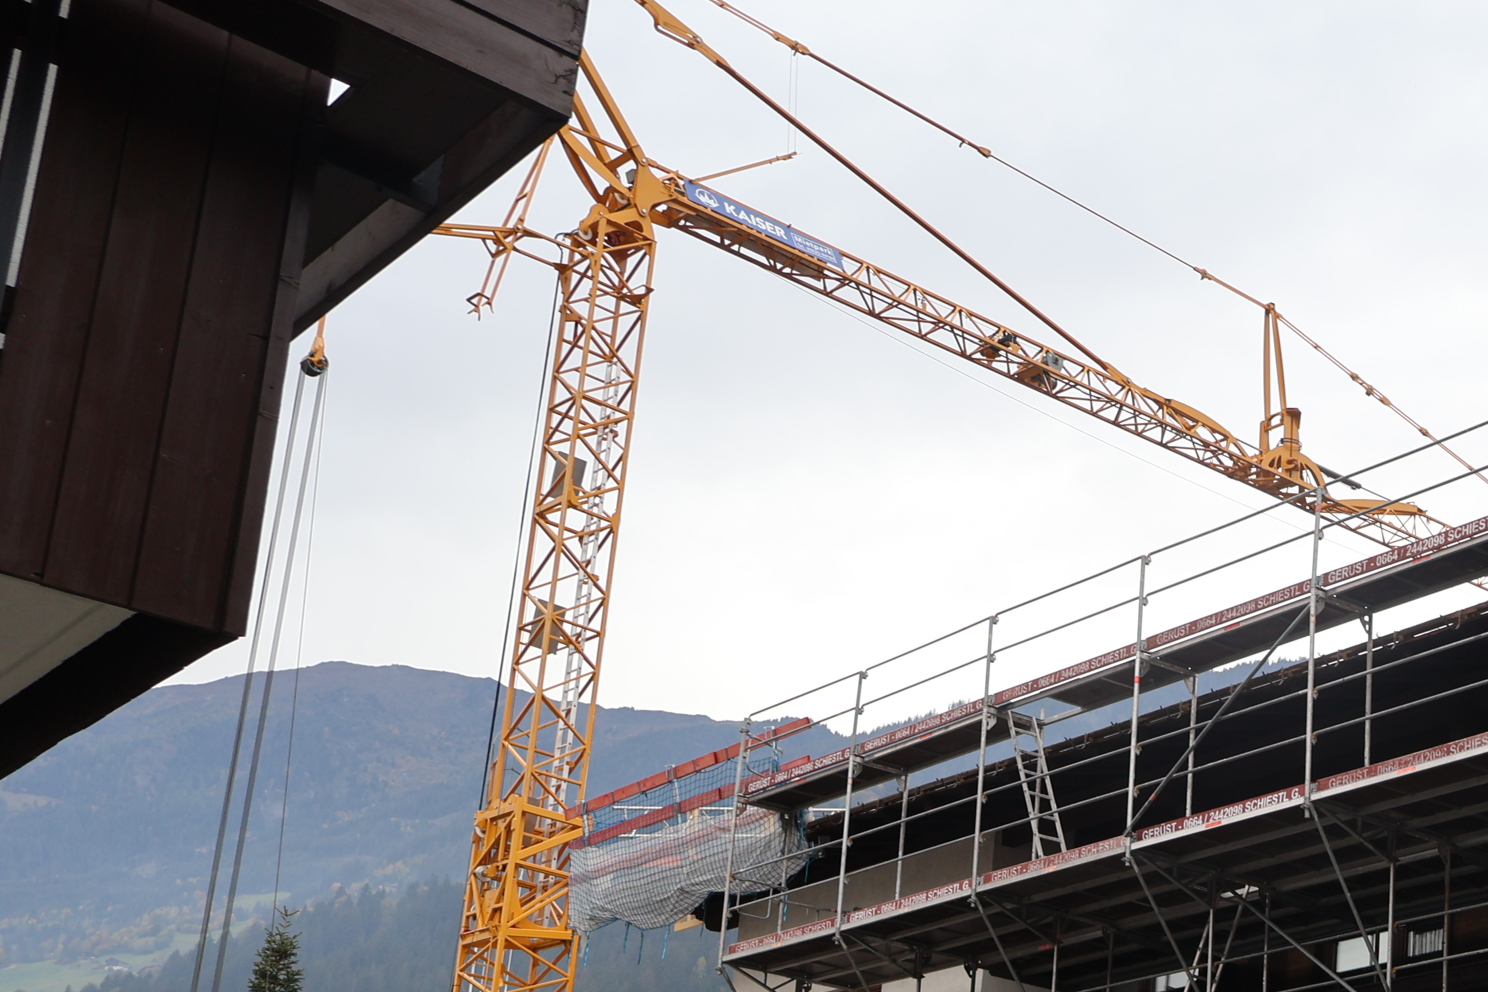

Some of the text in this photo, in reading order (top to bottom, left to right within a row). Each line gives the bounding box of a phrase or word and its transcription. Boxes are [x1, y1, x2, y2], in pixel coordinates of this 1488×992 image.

[723, 201, 789, 240] KAISER
[1376, 548, 1397, 566] 0664
[1406, 532, 1444, 556] 2442098
[1142, 787, 1300, 839] GERÜST 0664 2442098 SCHIESTL G.
